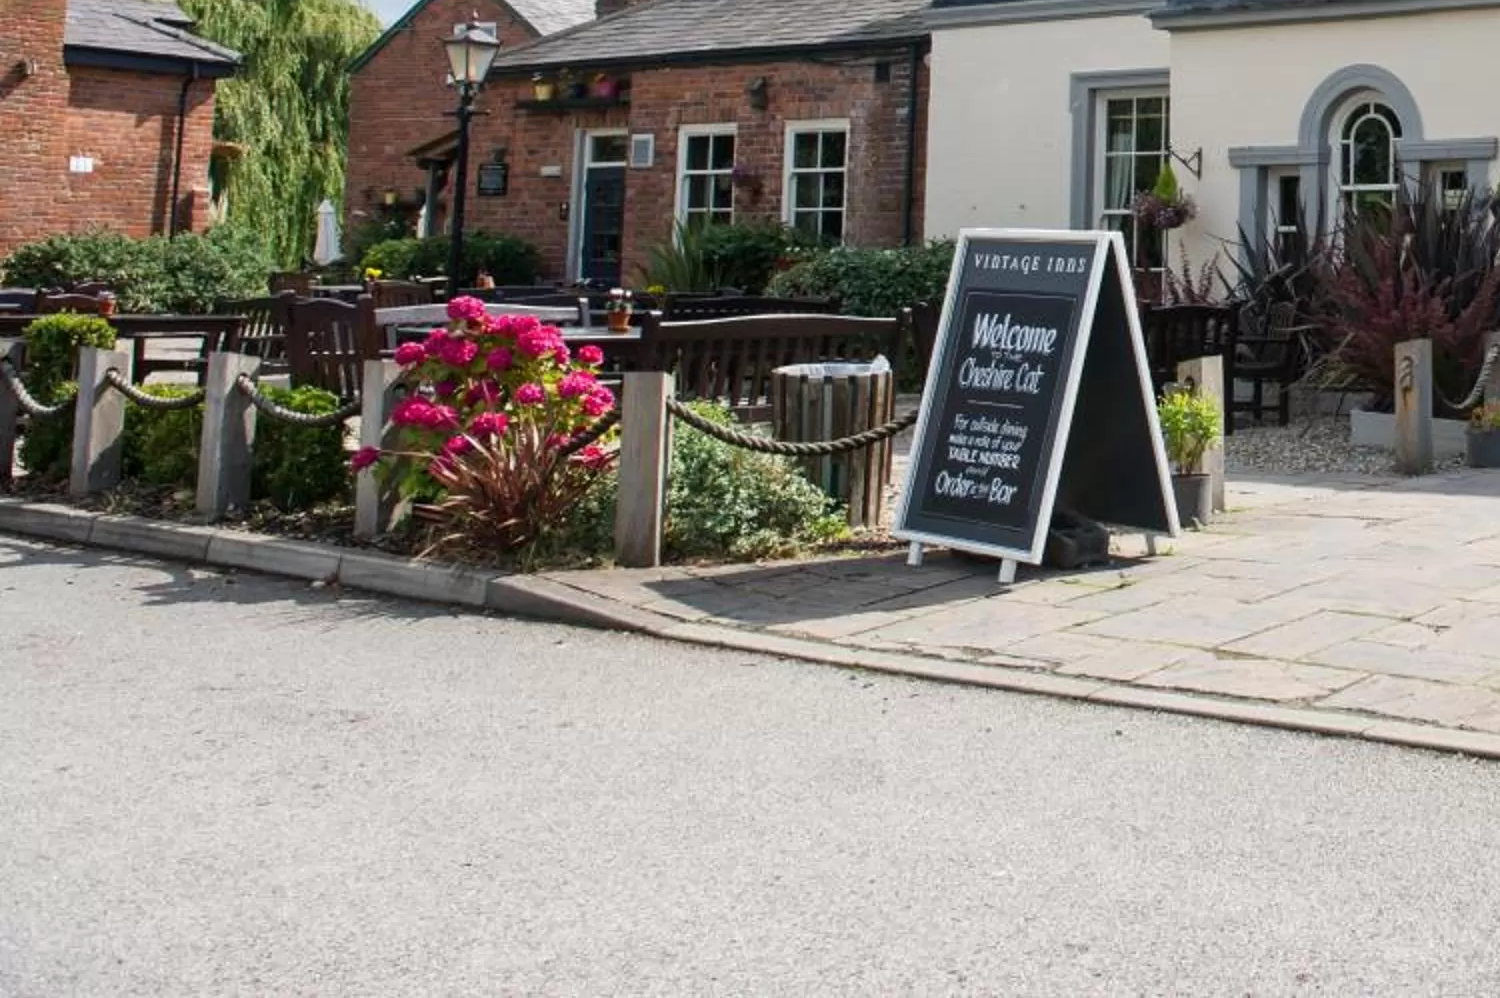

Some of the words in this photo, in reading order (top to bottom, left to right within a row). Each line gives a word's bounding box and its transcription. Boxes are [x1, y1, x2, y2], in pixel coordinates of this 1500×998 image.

[974, 254, 1041, 275] VINTAGE
[1047, 256, 1087, 274] INNS
[971, 313, 1057, 353] Welcome
[959, 357, 1014, 390] Cheshire
[1015, 363, 1044, 394] Cat
[935, 470, 975, 499] Order
[988, 477, 1018, 505] Bar
